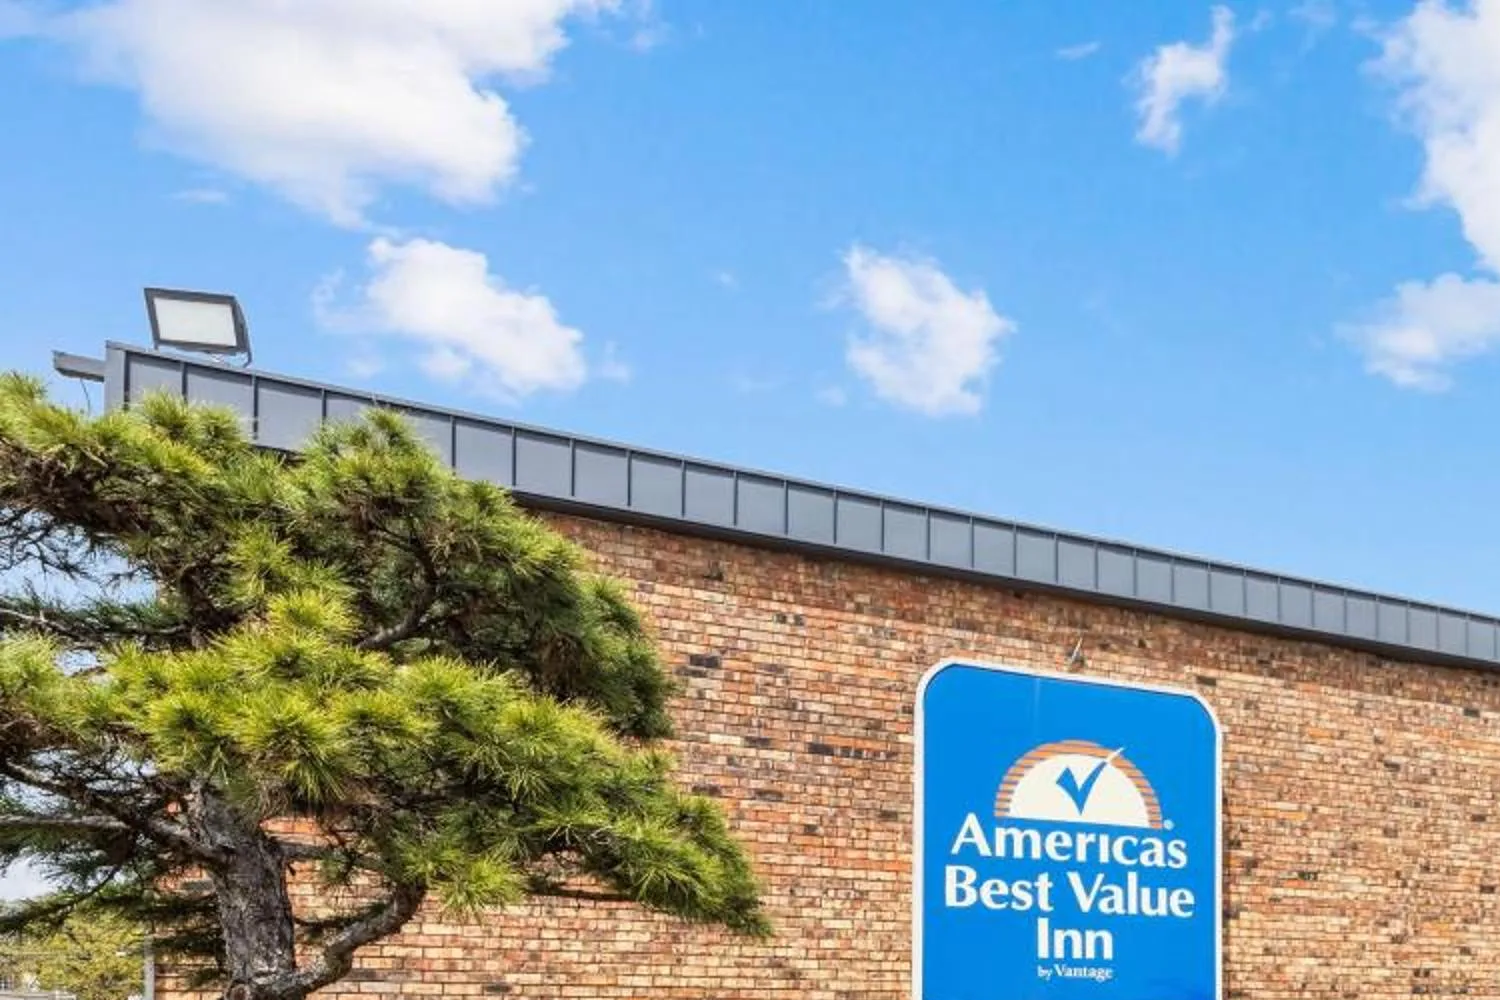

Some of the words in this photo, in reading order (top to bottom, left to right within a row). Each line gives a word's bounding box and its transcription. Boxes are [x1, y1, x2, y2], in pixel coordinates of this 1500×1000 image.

[951, 812, 1188, 869] Americas
[944, 864, 1055, 912] Best
[1066, 870, 1196, 918] Value
[1036, 916, 1115, 961] Inn
[1037, 965, 1053, 981] by
[1053, 963, 1115, 983] Vantage
